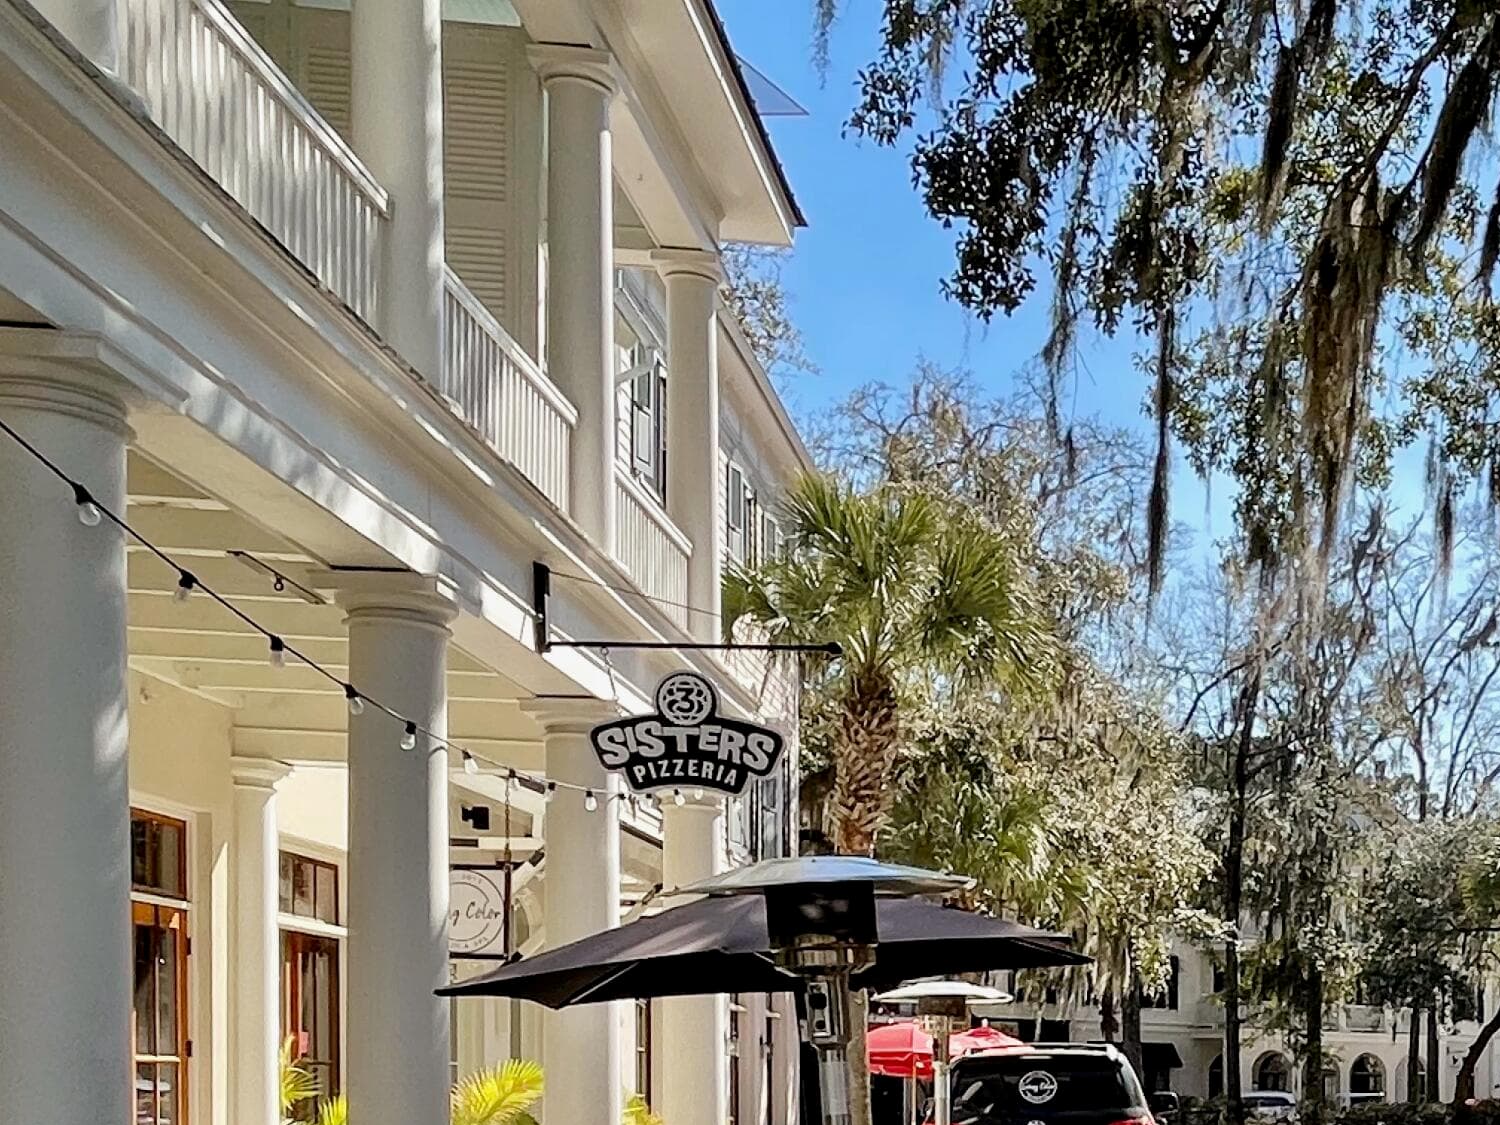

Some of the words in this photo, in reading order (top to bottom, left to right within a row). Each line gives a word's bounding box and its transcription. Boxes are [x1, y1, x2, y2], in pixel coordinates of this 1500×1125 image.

[597, 720, 775, 771] SISTERS
[633, 759, 737, 787] PIZZERIA
[466, 901, 502, 920] Color
